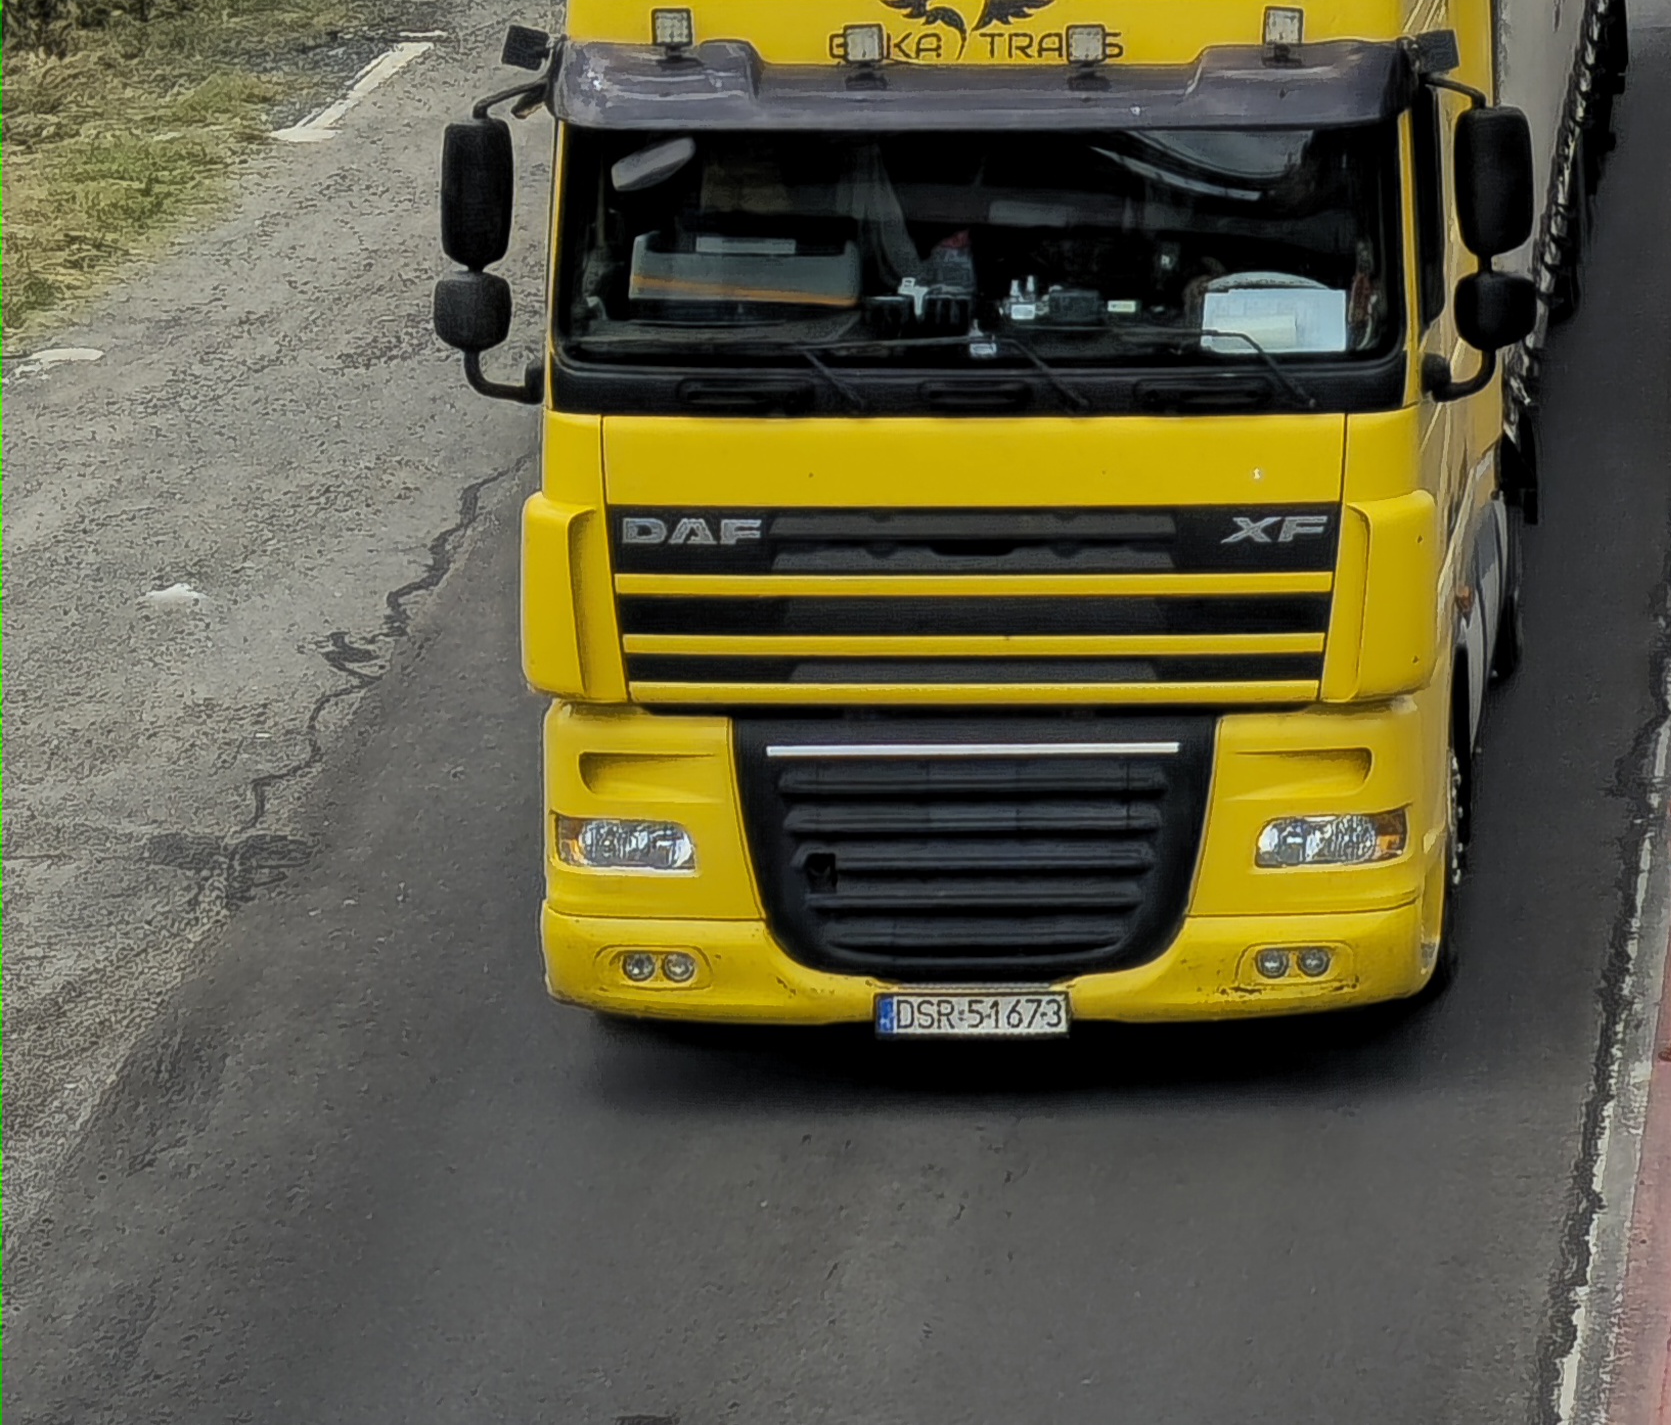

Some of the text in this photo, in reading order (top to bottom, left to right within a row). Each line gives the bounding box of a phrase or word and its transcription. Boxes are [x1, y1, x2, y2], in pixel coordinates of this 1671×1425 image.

[980, 32, 1124, 59] TRAS
[622, 518, 762, 545] DAF
[1220, 515, 1328, 544] XF
